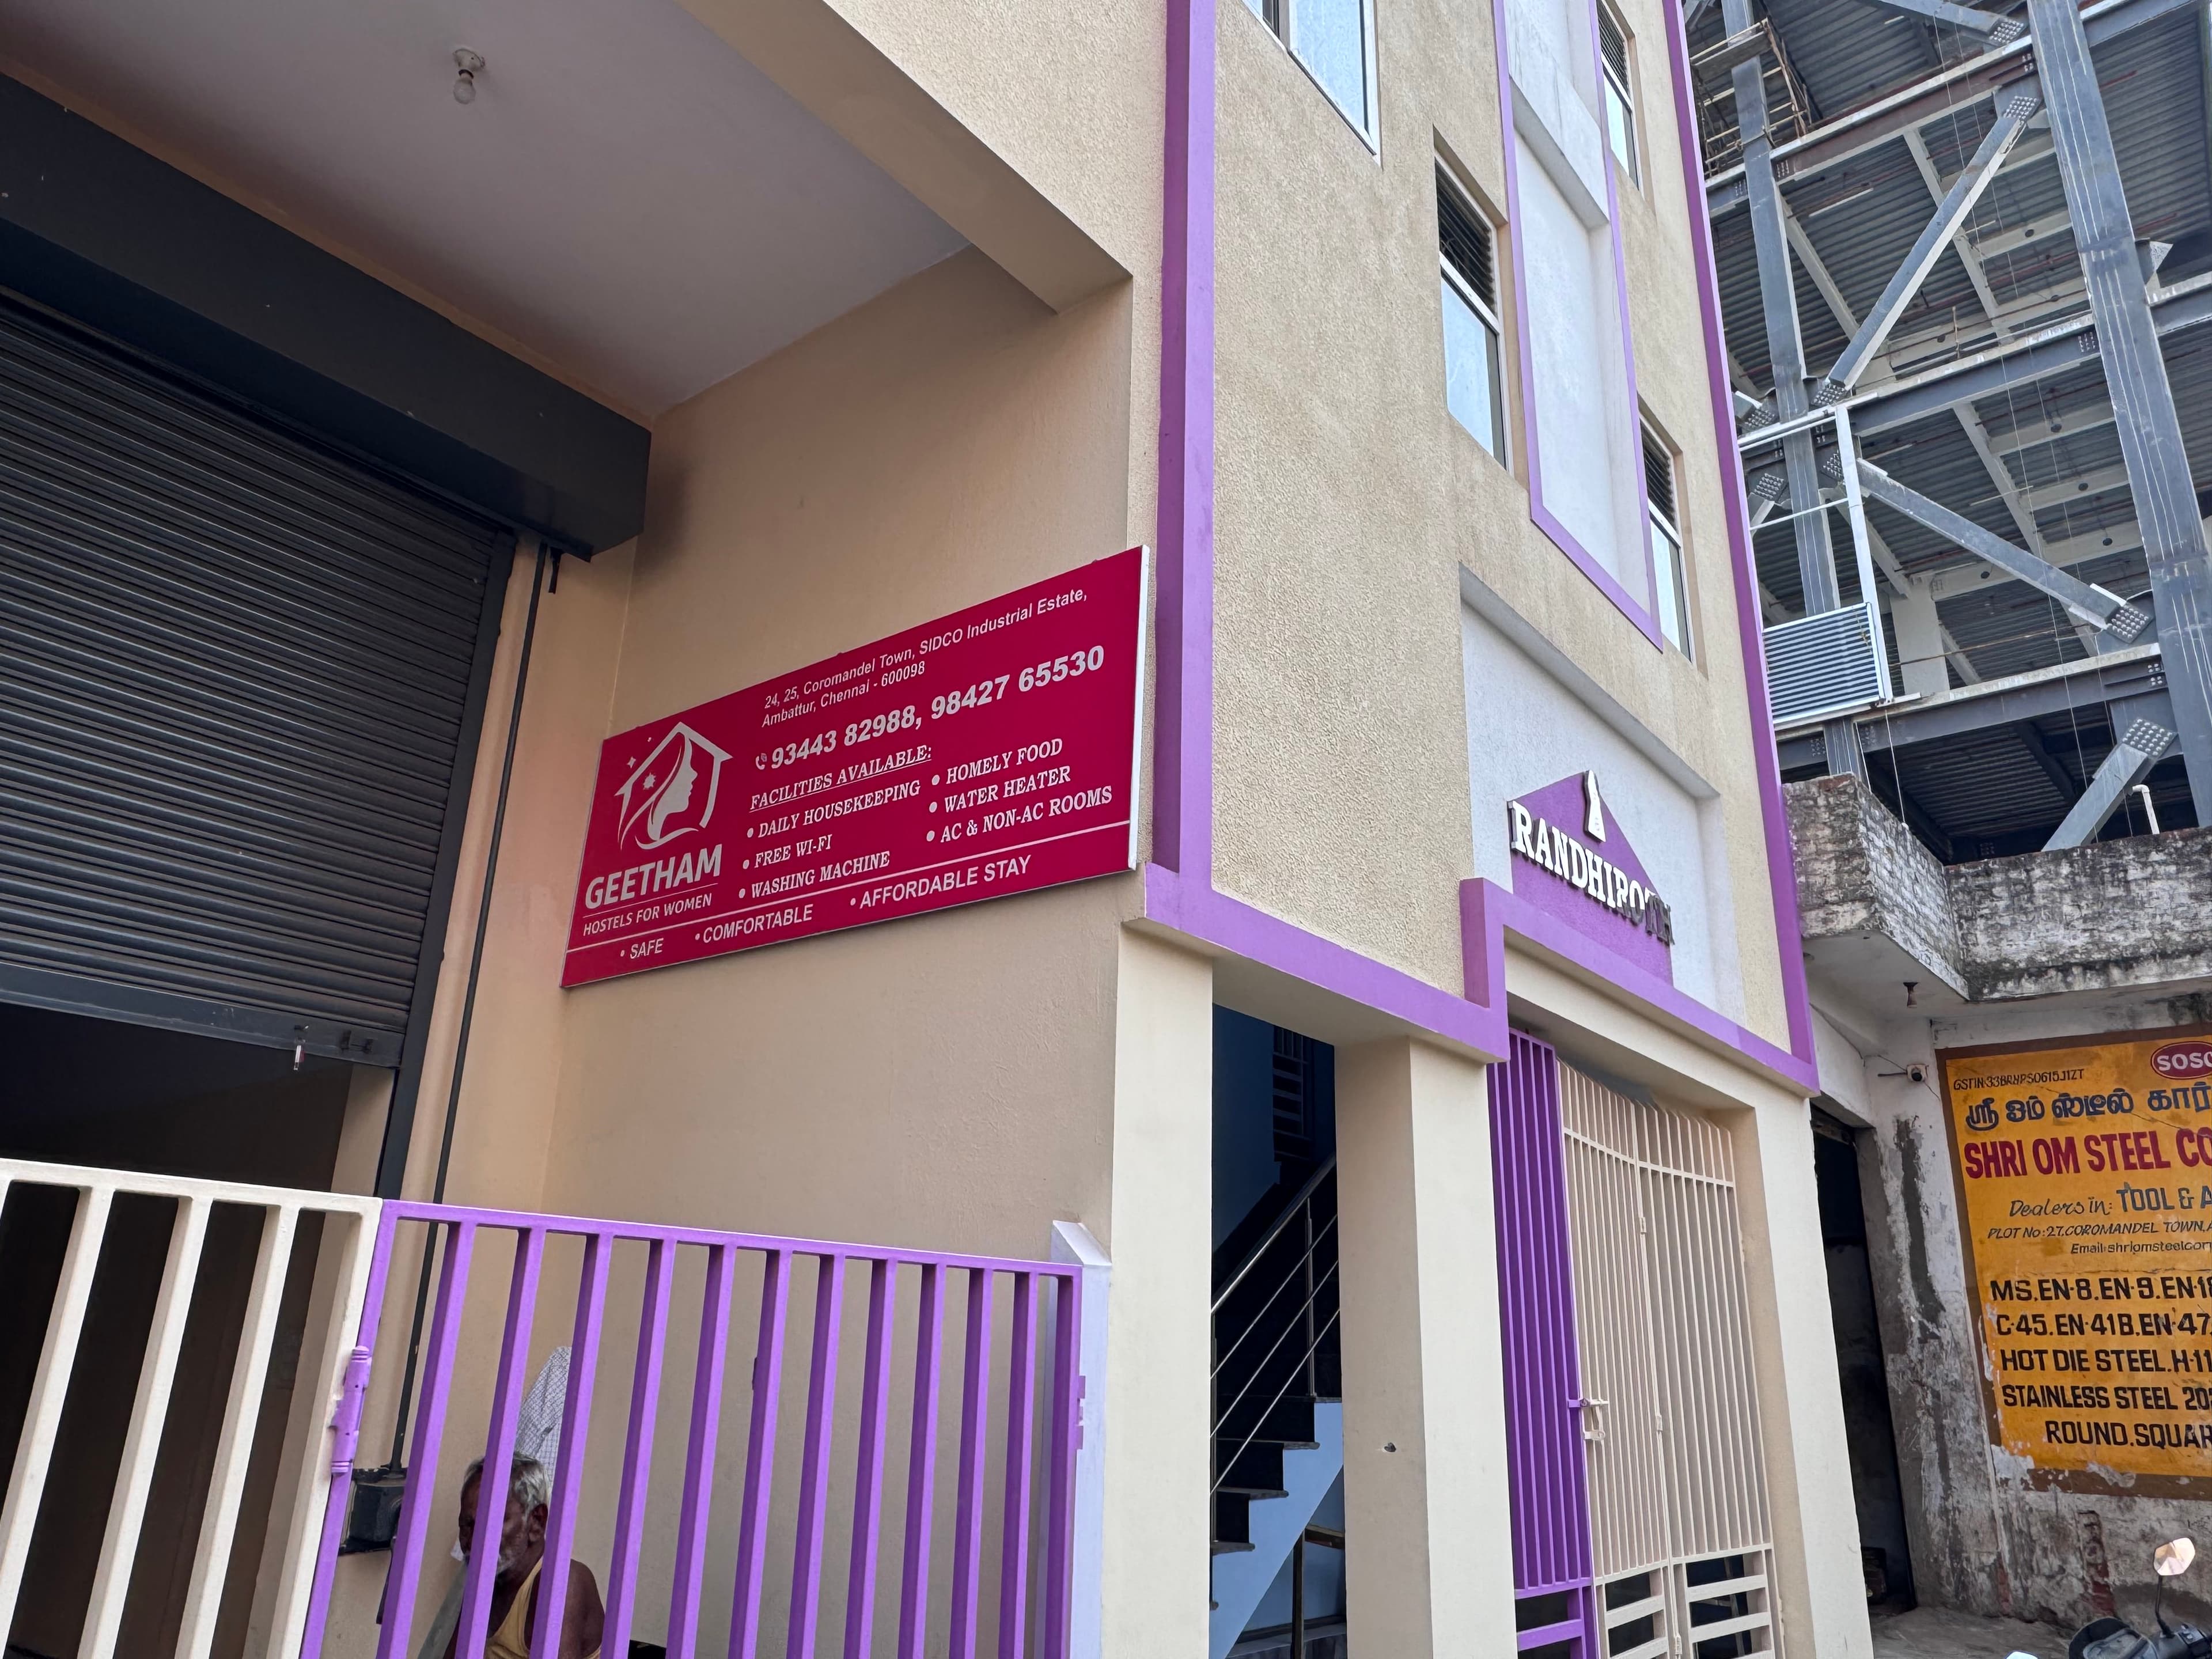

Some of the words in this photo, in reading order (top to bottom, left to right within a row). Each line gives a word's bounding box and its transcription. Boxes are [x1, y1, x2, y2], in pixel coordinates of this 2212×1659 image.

[764, 693, 780, 709] 24,
[783, 687, 799, 702] 25,
[804, 658, 875, 695] Coromandel
[880, 649, 915, 668] Town,
[919, 628, 963, 654] SIDCO
[967, 603, 1032, 639] Industrial
[1037, 589, 1087, 615] Estate,
[762, 702, 816, 728] Ambattur,
[820, 679, 869, 707] Chennai
[881, 661, 925, 687] 600098
[771, 730, 836, 769] 93443
[844, 705, 922, 746] 82988,
[931, 674, 1010, 719] 98427
[1018, 645, 1104, 692] 65530
[750, 773, 833, 810] FACILITIES
[836, 745, 931, 785] AVAILABLE:
[946, 751, 1013, 785] HOMELY
[1016, 738, 1063, 766] FOOD
[758, 813, 800, 838] DAILY
[802, 779, 921, 825] HOUSEKEEPING
[944, 785, 998, 813] WATER
[1003, 766, 1071, 798] HEATER
[940, 823, 961, 843] AC
[966, 819, 978, 836] &
[982, 802, 1043, 832] NON-AC
[1048, 786, 1113, 817] ROOMS
[751, 869, 815, 898] WASHING
[819, 851, 891, 882] MACHINE
[754, 845, 791, 868] FREE
[796, 834, 832, 857] WI-FI
[585, 844, 722, 909] GEETHAM
[859, 866, 979, 909] AFFORDABLE
[984, 854, 1031, 882] STAY
[583, 912, 633, 936] HOSTELS
[636, 906, 660, 923] FOR
[664, 893, 712, 916] WOMEN
[703, 904, 813, 944] COMFORTABLE
[630, 938, 664, 959] SAFE
[1964, 1139, 2028, 1179] SHRI
[2032, 1136, 2080, 1175] OM
[2084, 1131, 2171, 1172] STEEL
[2009, 1198, 2085, 1217] Dealers
[2116, 1184, 2175, 1213] TOOL
[2178, 1187, 2195, 1209] &
[1988, 1227, 2021, 1239] PLOT
[2001, 1349, 2048, 1371] HOT
[2053, 1349, 2090, 1371] DIE
[2002, 1384, 2111, 1408] STAINLESS
[2114, 1386, 2178, 1410] STEEL
[2182, 1387, 2212, 1410] 20
